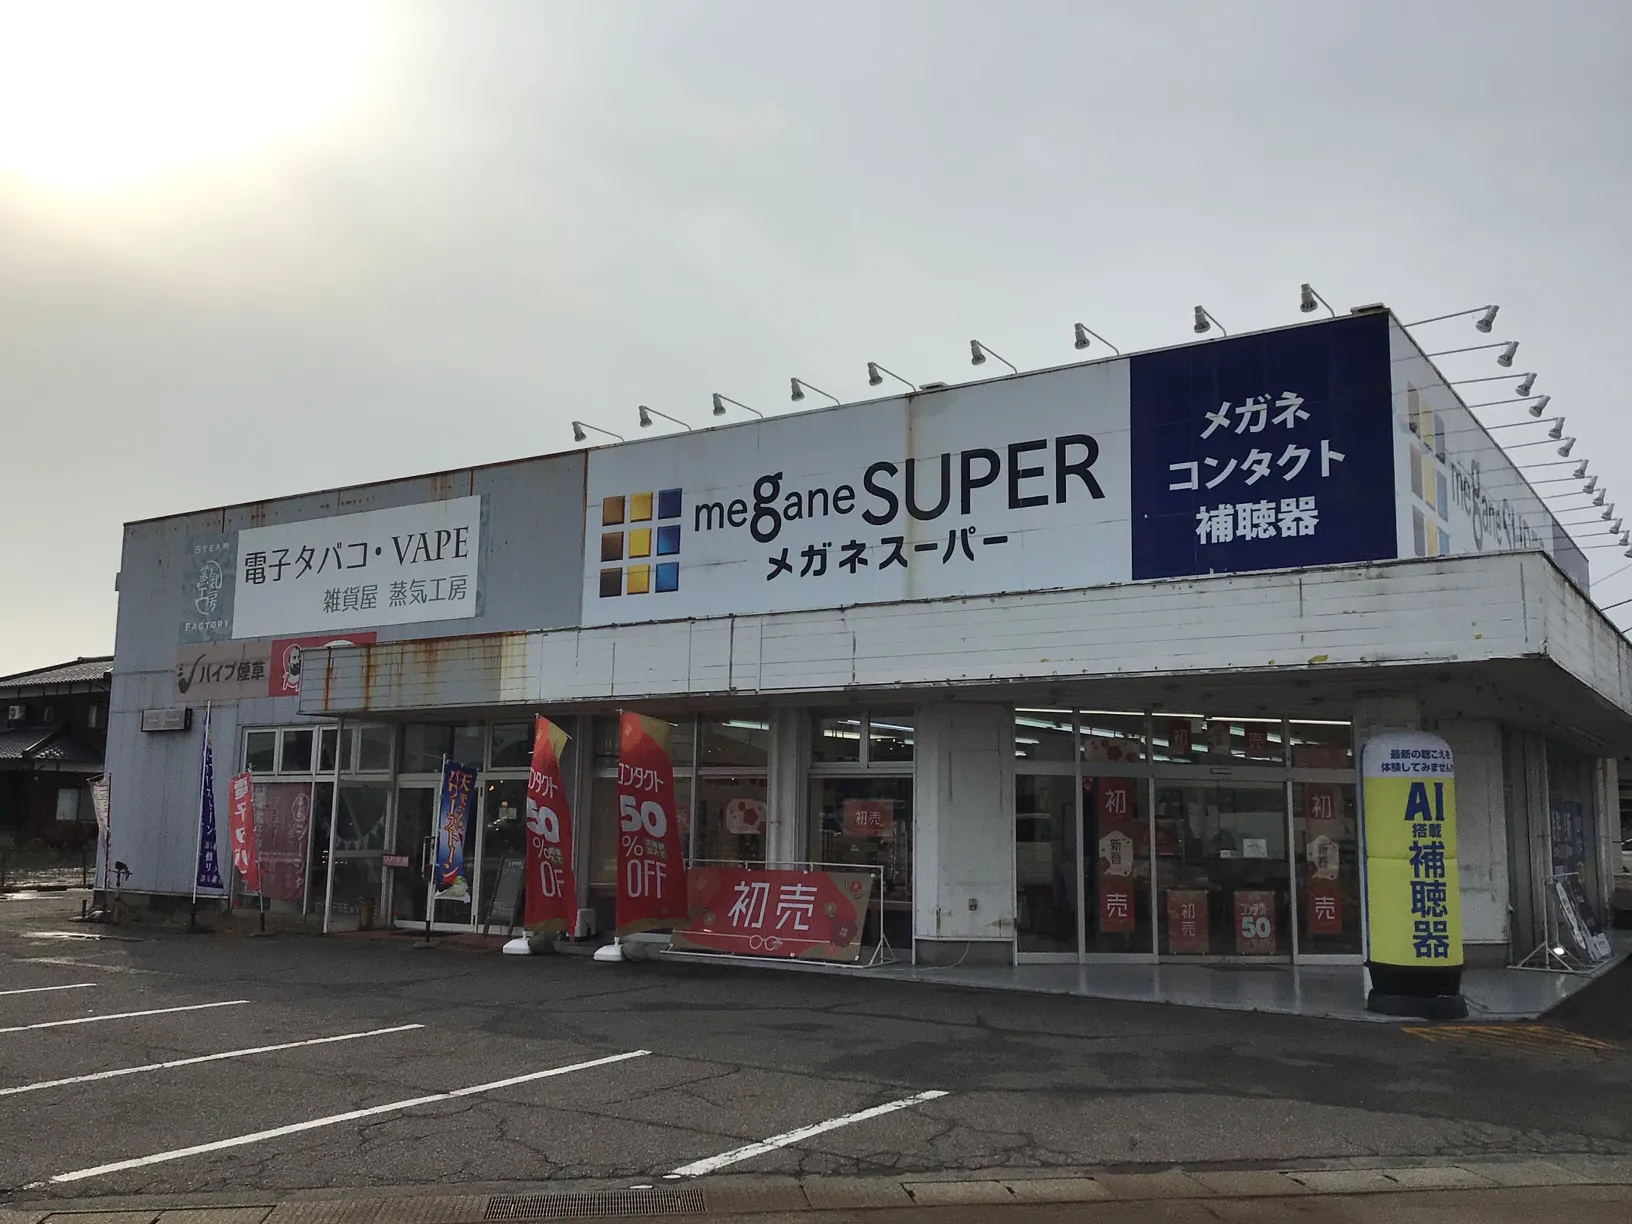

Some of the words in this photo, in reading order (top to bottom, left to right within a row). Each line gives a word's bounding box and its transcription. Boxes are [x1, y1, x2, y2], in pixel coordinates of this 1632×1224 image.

[1200, 391, 1311, 440] メガネ
[1169, 439, 1346, 491] コンタクト
[1196, 496, 1320, 545] 補聴器
[195, 542, 230, 554] STEAM
[766, 526, 1008, 582] メガネスーパー
[323, 585, 378, 614] 雑貨屋
[389, 574, 468, 608] 蒸気工房
[185, 620, 229, 632] FACTORY
[200, 661, 266, 681] パイプ煙草
[617, 762, 664, 794] コンタクト
[526, 797, 560, 843] 50
[620, 795, 667, 838] 50
[855, 810, 881, 826] 初売
[1404, 782, 1445, 821] AI
[1412, 823, 1442, 838] 搭載
[540, 861, 564, 898] OF
[626, 859, 668, 898] OFF
[728, 880, 818, 931] 初売
[1408, 841, 1450, 958] 補聴器
[1181, 902, 1196, 937] 初売
[1241, 916, 1271, 939] 50
